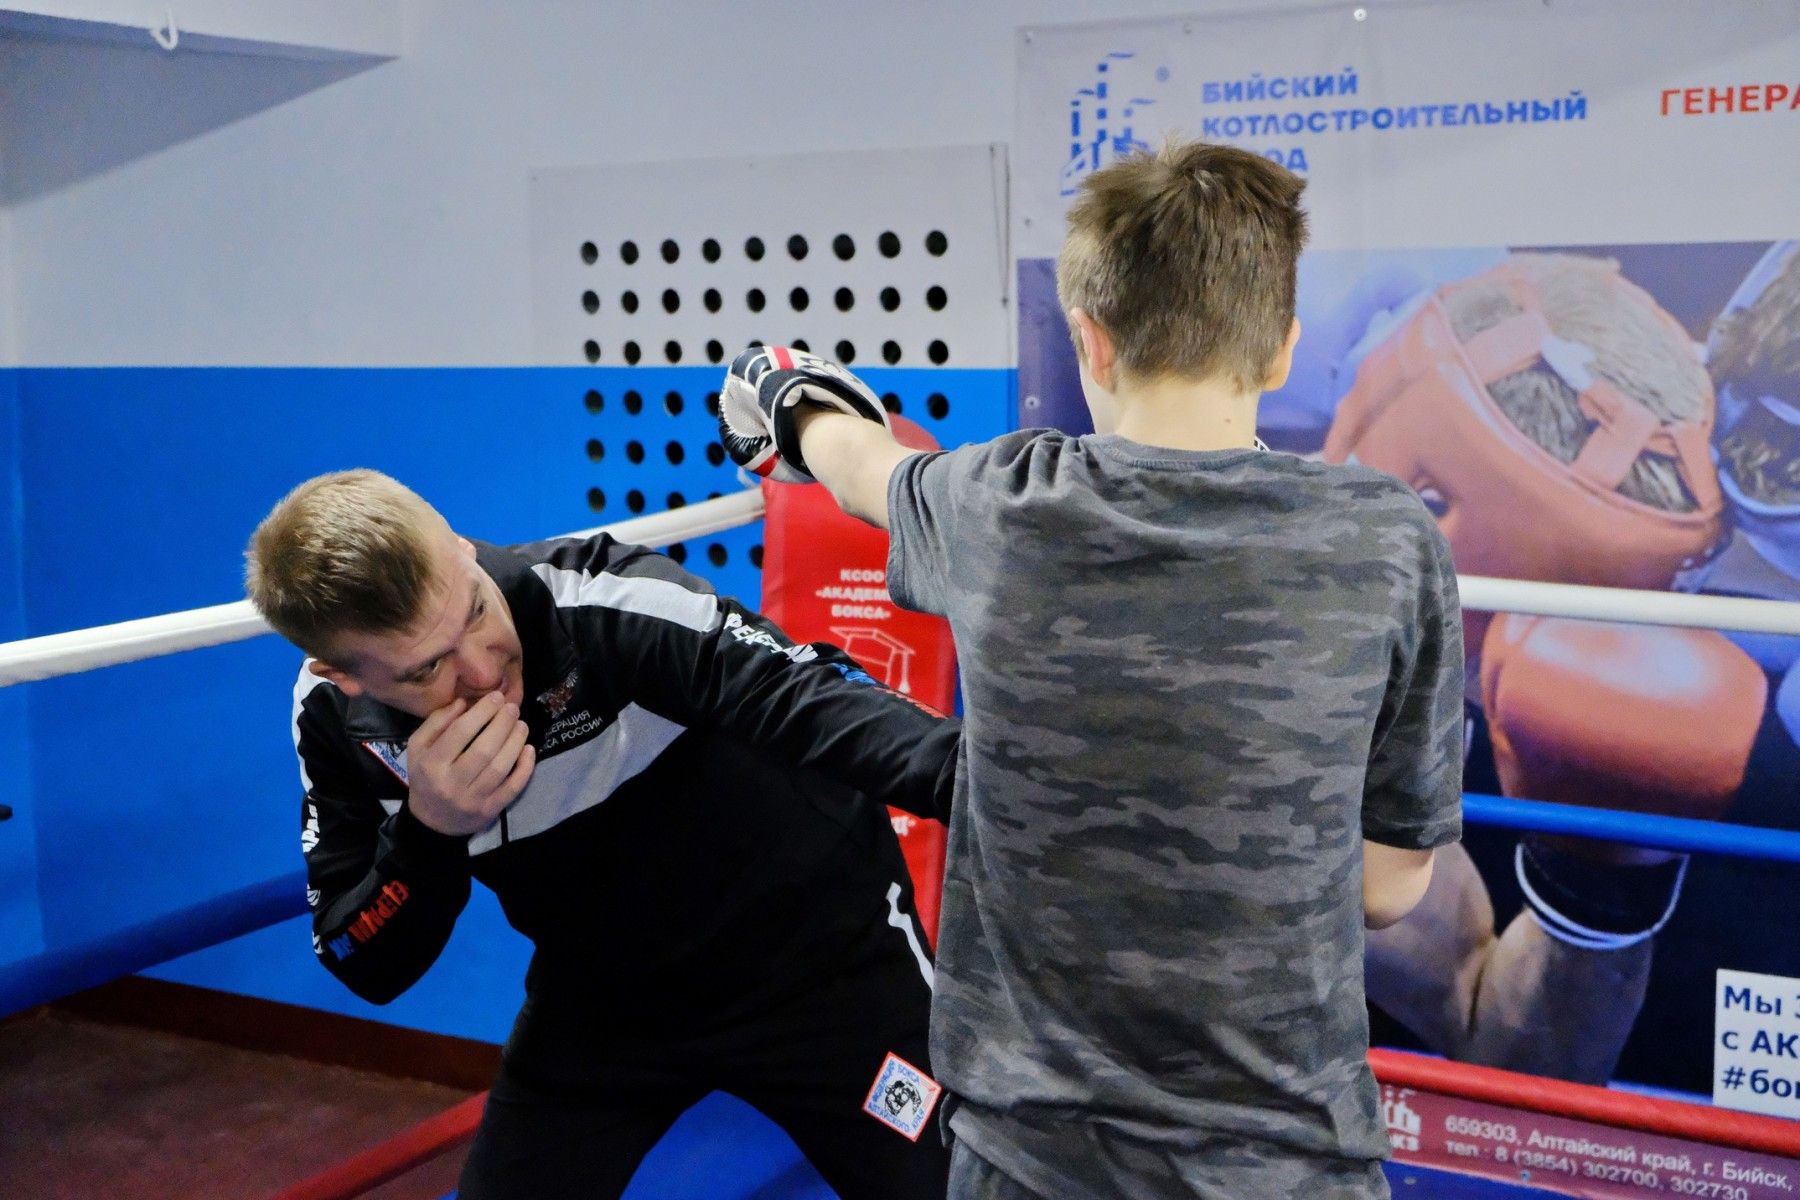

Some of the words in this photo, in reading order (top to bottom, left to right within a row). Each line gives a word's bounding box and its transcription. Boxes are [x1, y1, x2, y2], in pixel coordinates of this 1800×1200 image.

[1202, 67, 1359, 104] БИЙСКИЙ
[1202, 90, 1588, 138] КОТЛОСТРОИТЕЛЬНЫЙ
[546, 709, 591, 736] ЕРАЦИЯ
[560, 716, 604, 742] РОССИИ
[1724, 985, 1782, 1015] Мы
[1721, 1030, 1739, 1050] с
[1750, 1029, 1800, 1059] АК
[1445, 1114, 1523, 1146] 659303,
[1527, 1128, 1637, 1164] Алтайский
[1641, 1151, 1697, 1176] край,
[1722, 1160, 1794, 1192] Бийск,
[1513, 1150, 1579, 1176] (3854)
[1583, 1161, 1665, 1191] 302700,
